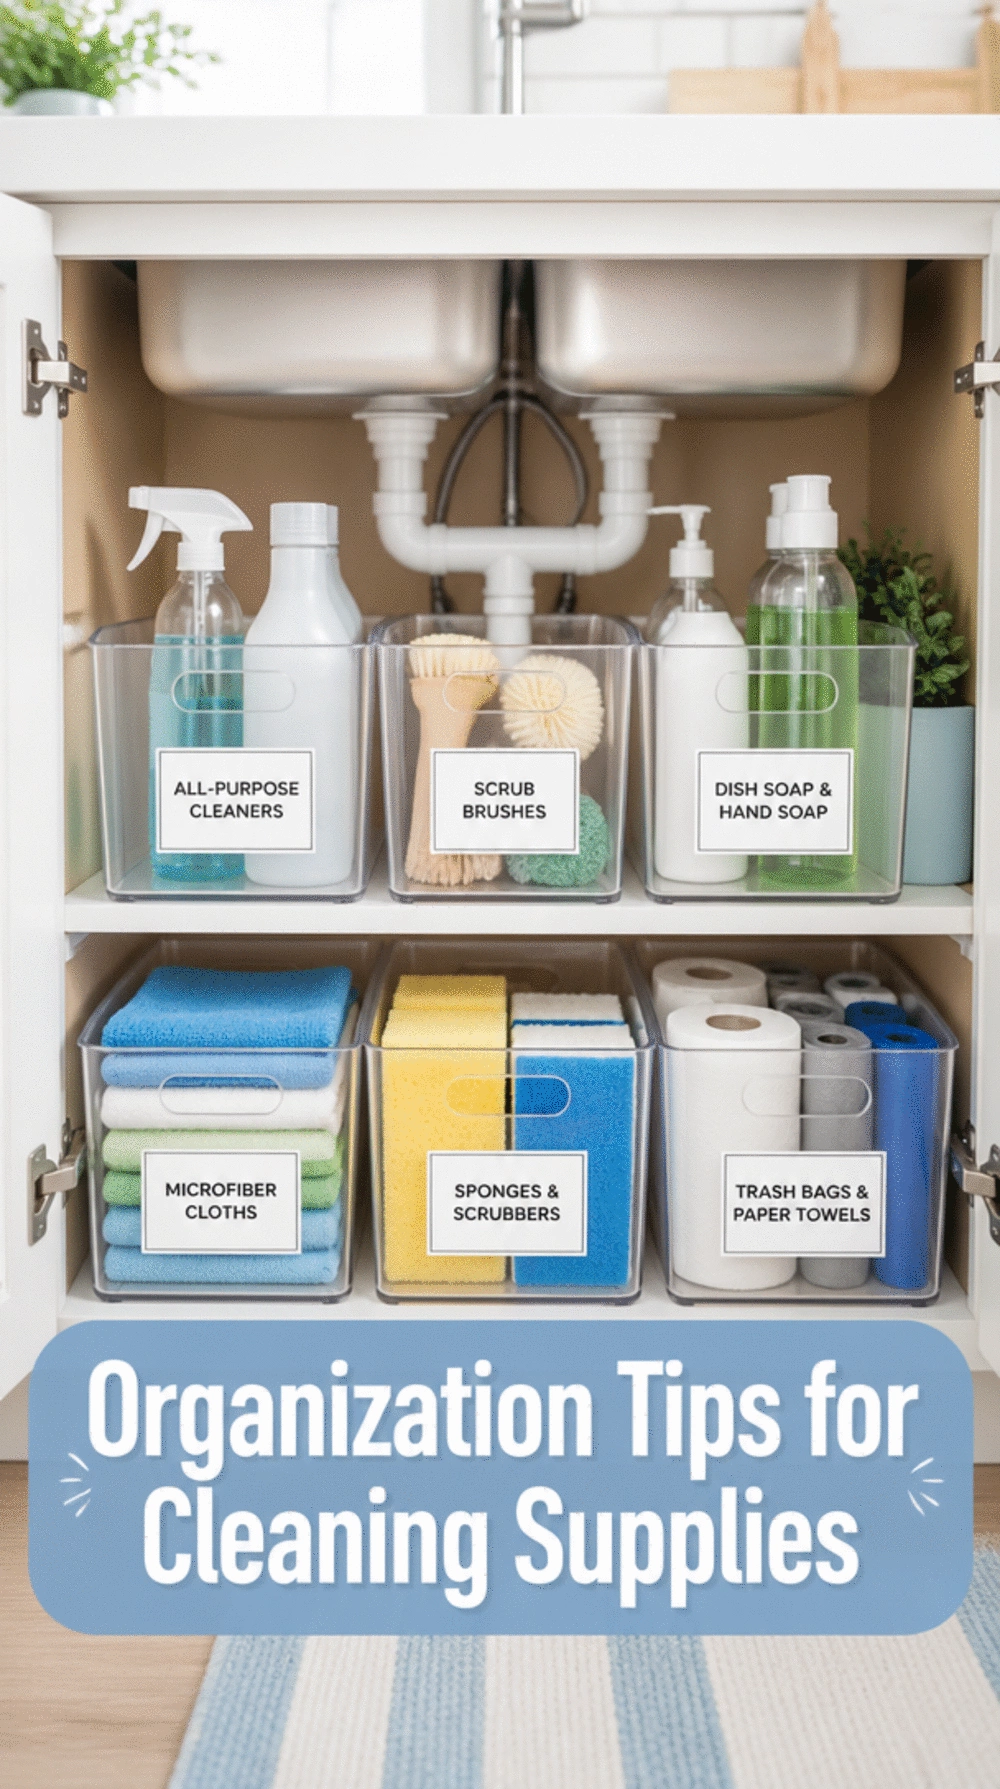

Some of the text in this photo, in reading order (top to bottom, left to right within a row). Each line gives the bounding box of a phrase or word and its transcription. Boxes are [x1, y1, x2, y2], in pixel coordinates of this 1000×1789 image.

[173, 781, 299, 796] ALL-PURPOSE
[474, 781, 535, 797] SCRUB
[715, 782, 832, 797] DISH SOAP &
[189, 803, 284, 819] CLEANERS
[463, 804, 547, 819] BRUSHES
[719, 804, 828, 820] HAND SOAP
[165, 1182, 277, 1197] MICROFIBER
[455, 1183, 559, 1199] SPONGES &
[735, 1184, 869, 1200] TRASH BAGS &
[185, 1204, 258, 1220] CLOTHS
[453, 1205, 561, 1221] SCRUBBERS
[733, 1207, 871, 1222] PAPER TOWELS
